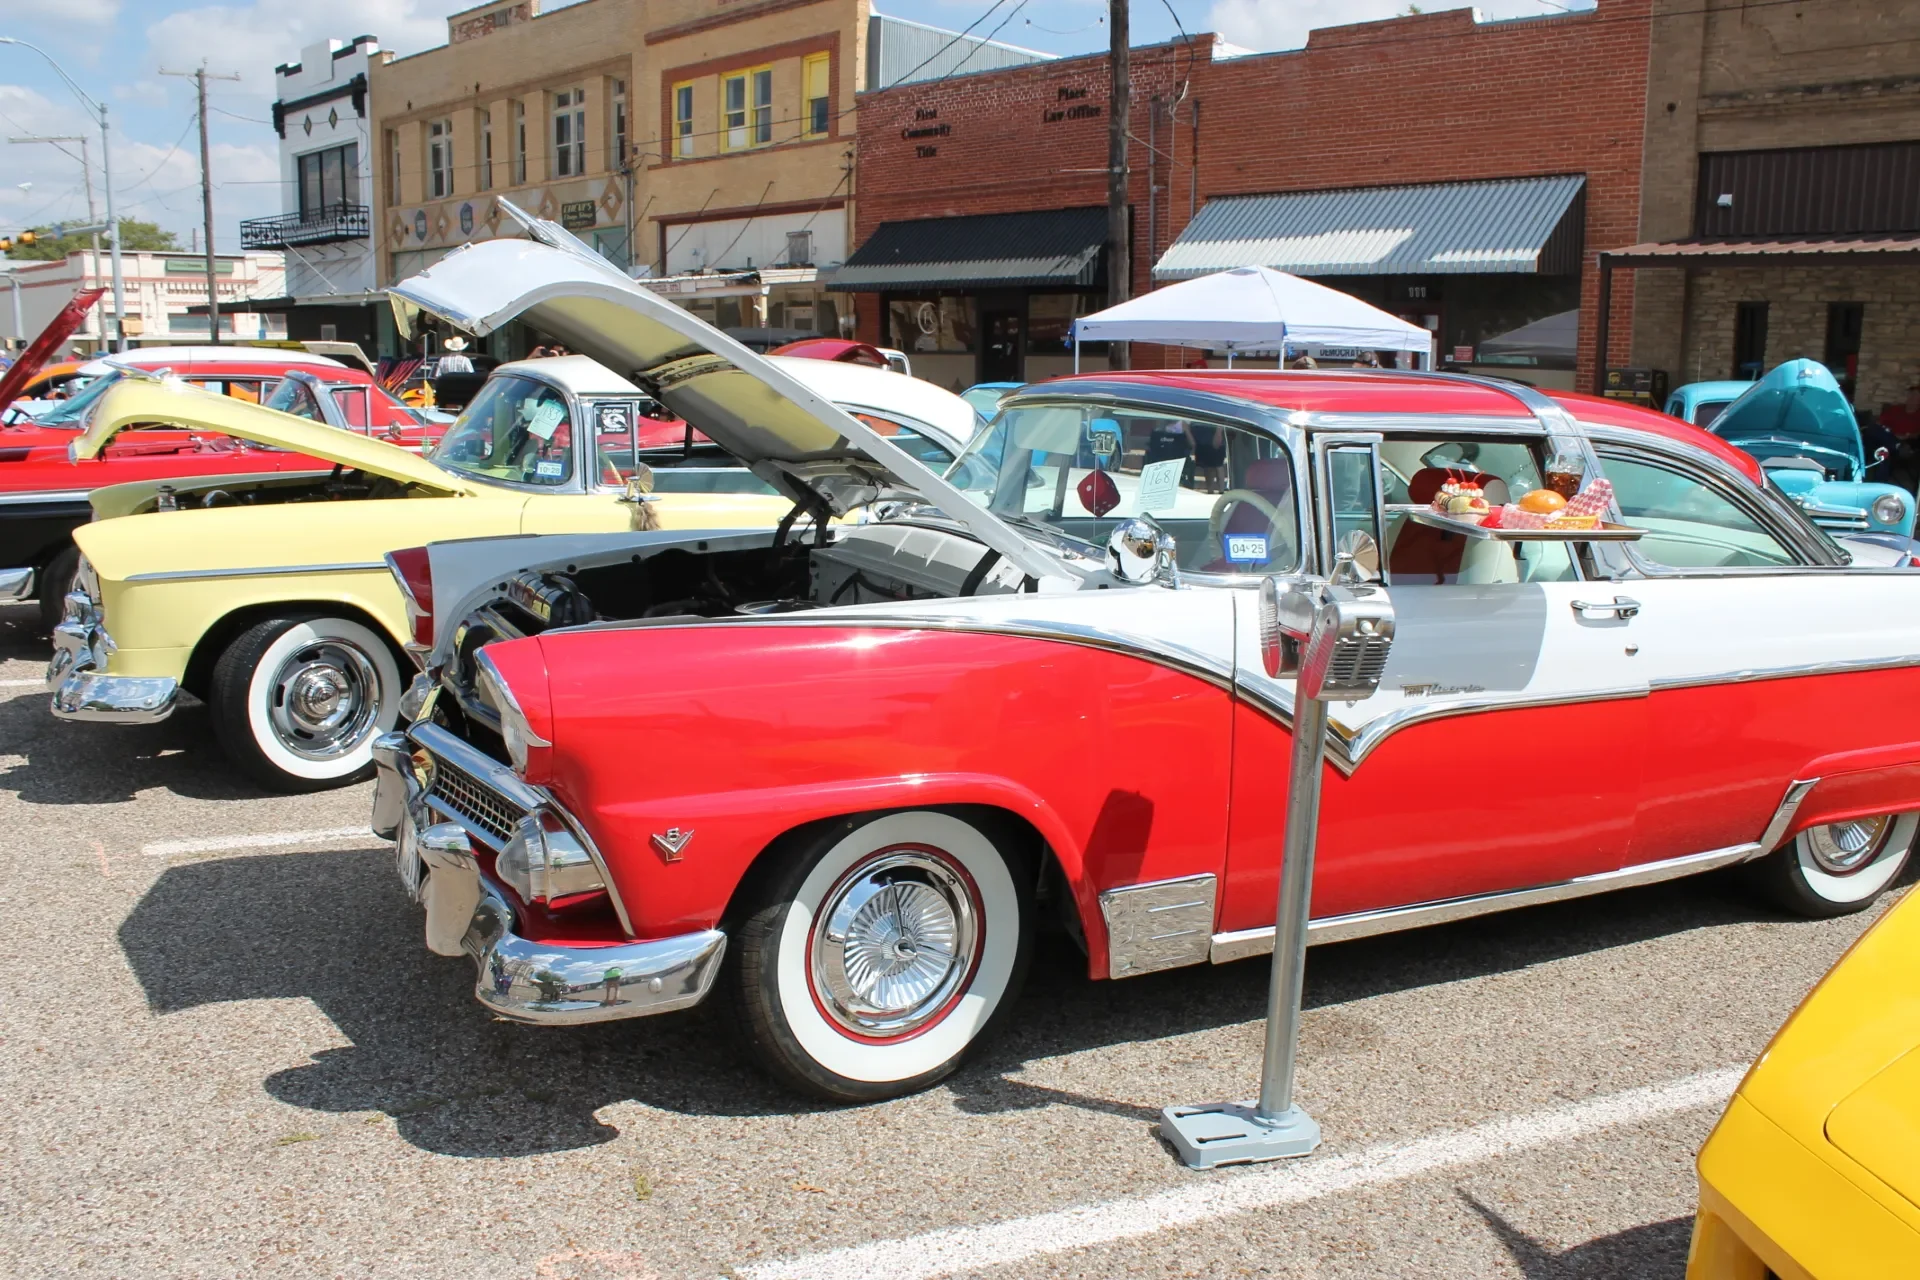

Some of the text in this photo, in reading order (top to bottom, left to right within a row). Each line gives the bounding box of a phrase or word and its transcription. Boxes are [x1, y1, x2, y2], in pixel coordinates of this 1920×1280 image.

[1057, 87, 1087, 101] Place
[915, 108, 938, 122] First
[1043, 104, 1102, 123] Law Office
[901, 123, 951, 140] Community
[915, 145, 938, 158] Title
[1408, 286, 1427, 298] 111
[1319, 347, 1364, 358] DEMOCRAT
[1149, 469, 1171, 486] 168
[1231, 544, 1264, 554] 04 25
